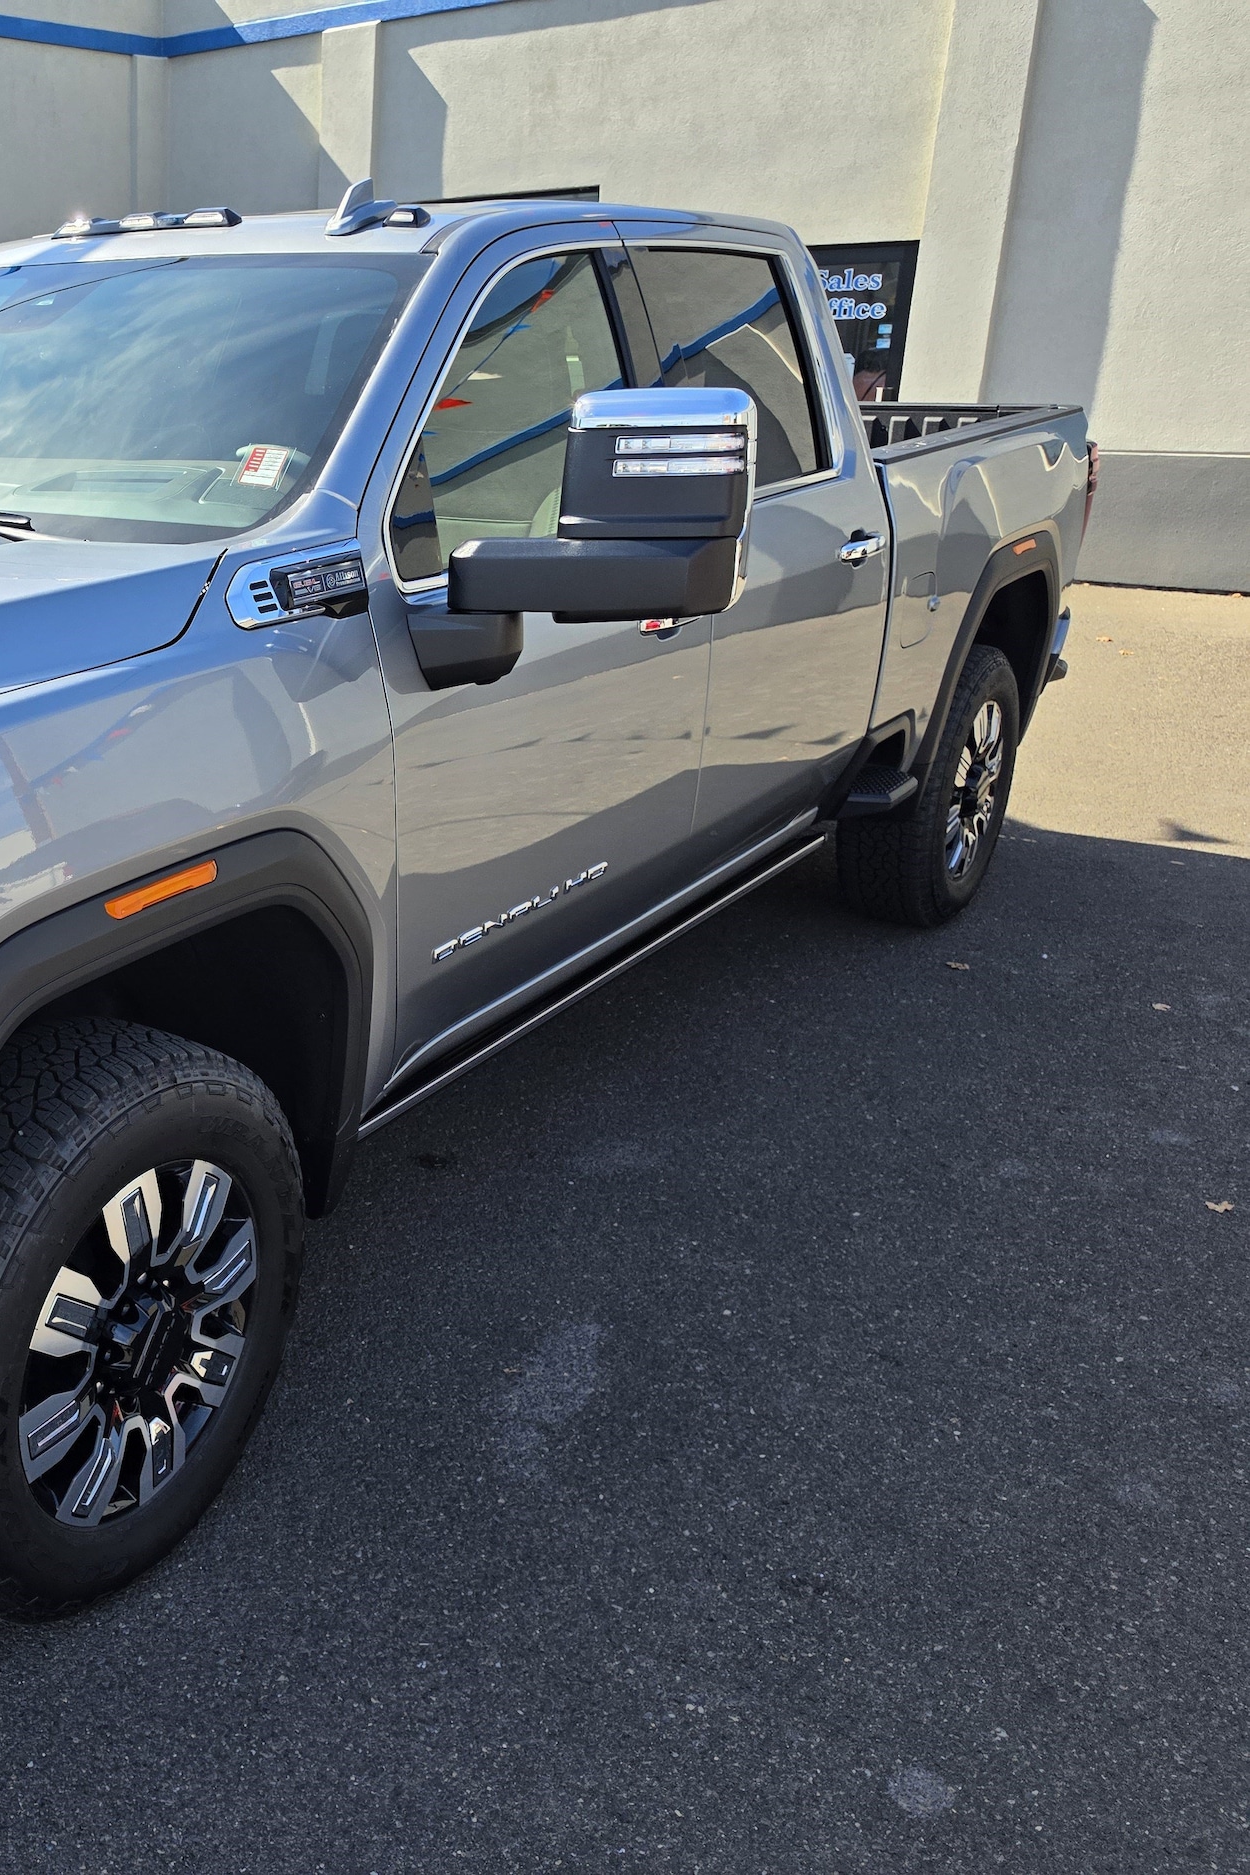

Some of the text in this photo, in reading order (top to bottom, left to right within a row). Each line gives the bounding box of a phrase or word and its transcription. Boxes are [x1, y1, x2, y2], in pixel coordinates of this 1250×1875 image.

[818, 268, 883, 292] Sales
[828, 297, 887, 320] ffice
[431, 885, 559, 964] DENALI
